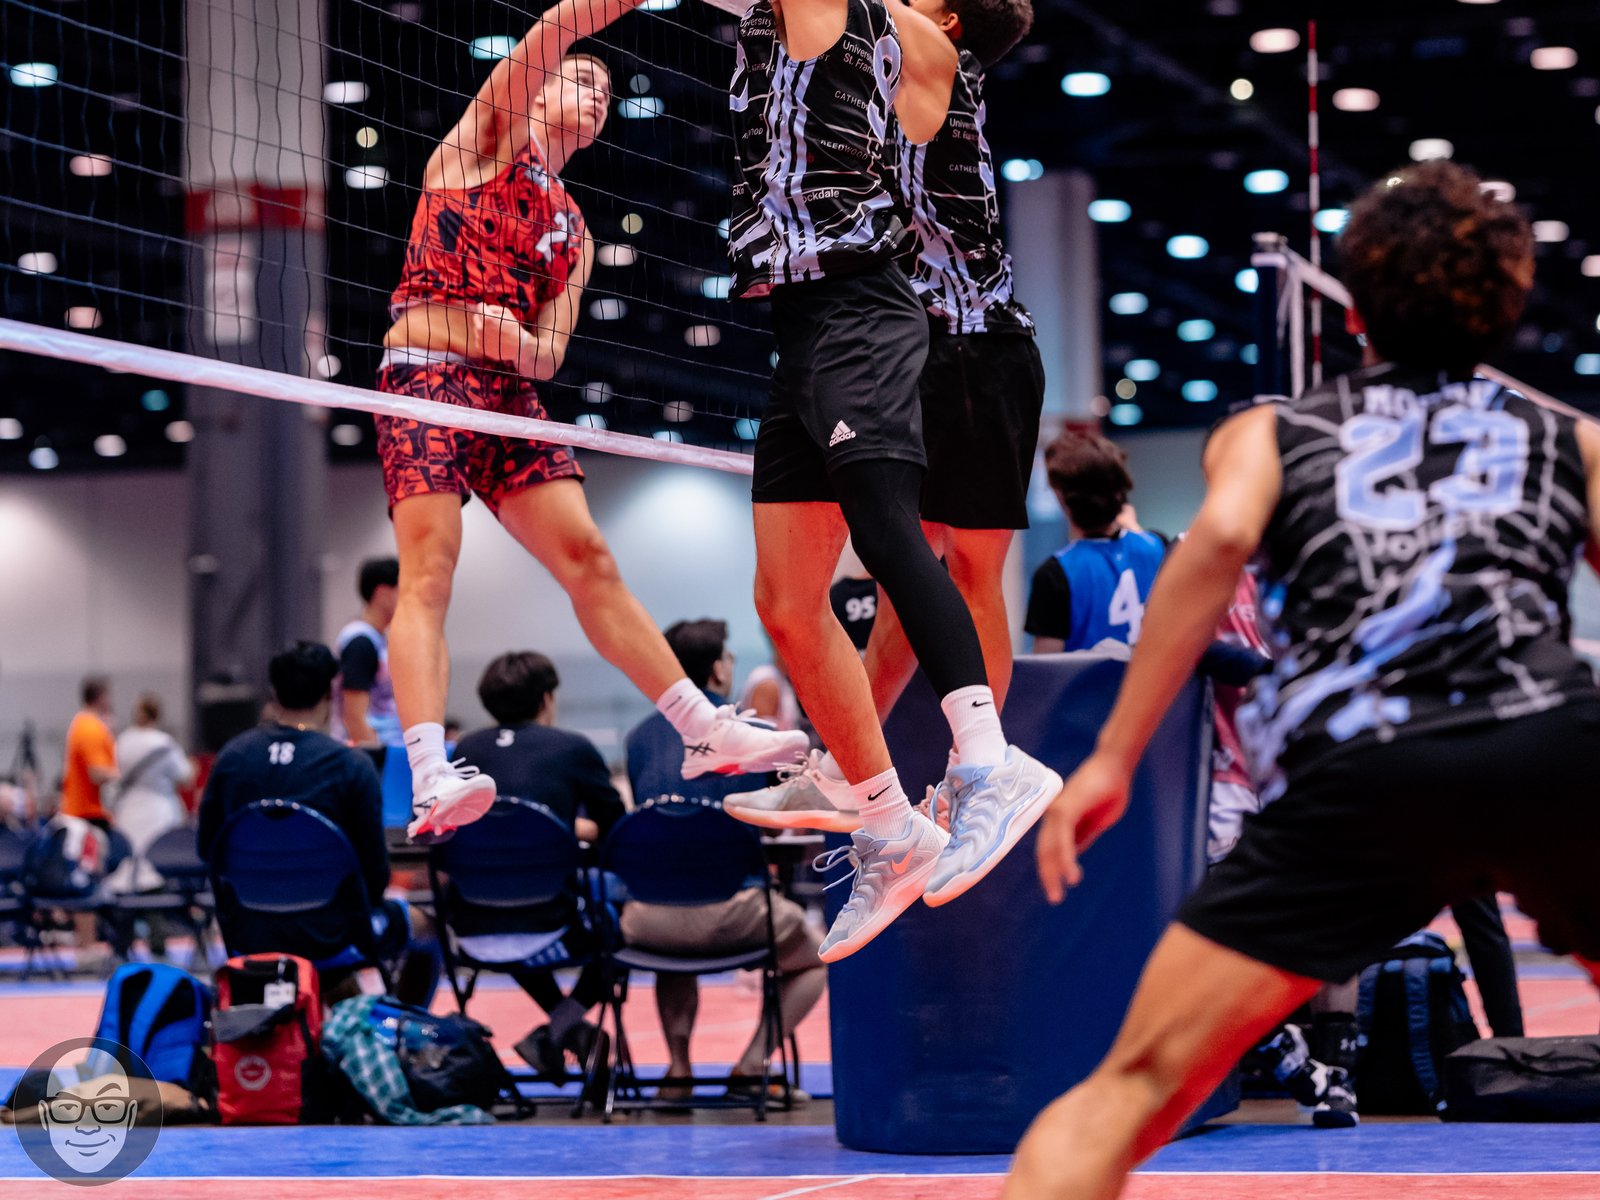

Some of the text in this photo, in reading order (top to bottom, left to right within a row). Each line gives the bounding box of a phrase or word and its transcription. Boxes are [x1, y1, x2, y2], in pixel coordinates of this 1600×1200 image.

[834, 90, 868, 111] CATHED
[802, 187, 840, 203] ockdale
[829, 430, 857, 448] adidas
[1335, 406, 1530, 534] 23
[1108, 567, 1145, 646] 4
[268, 741, 296, 765] 18
